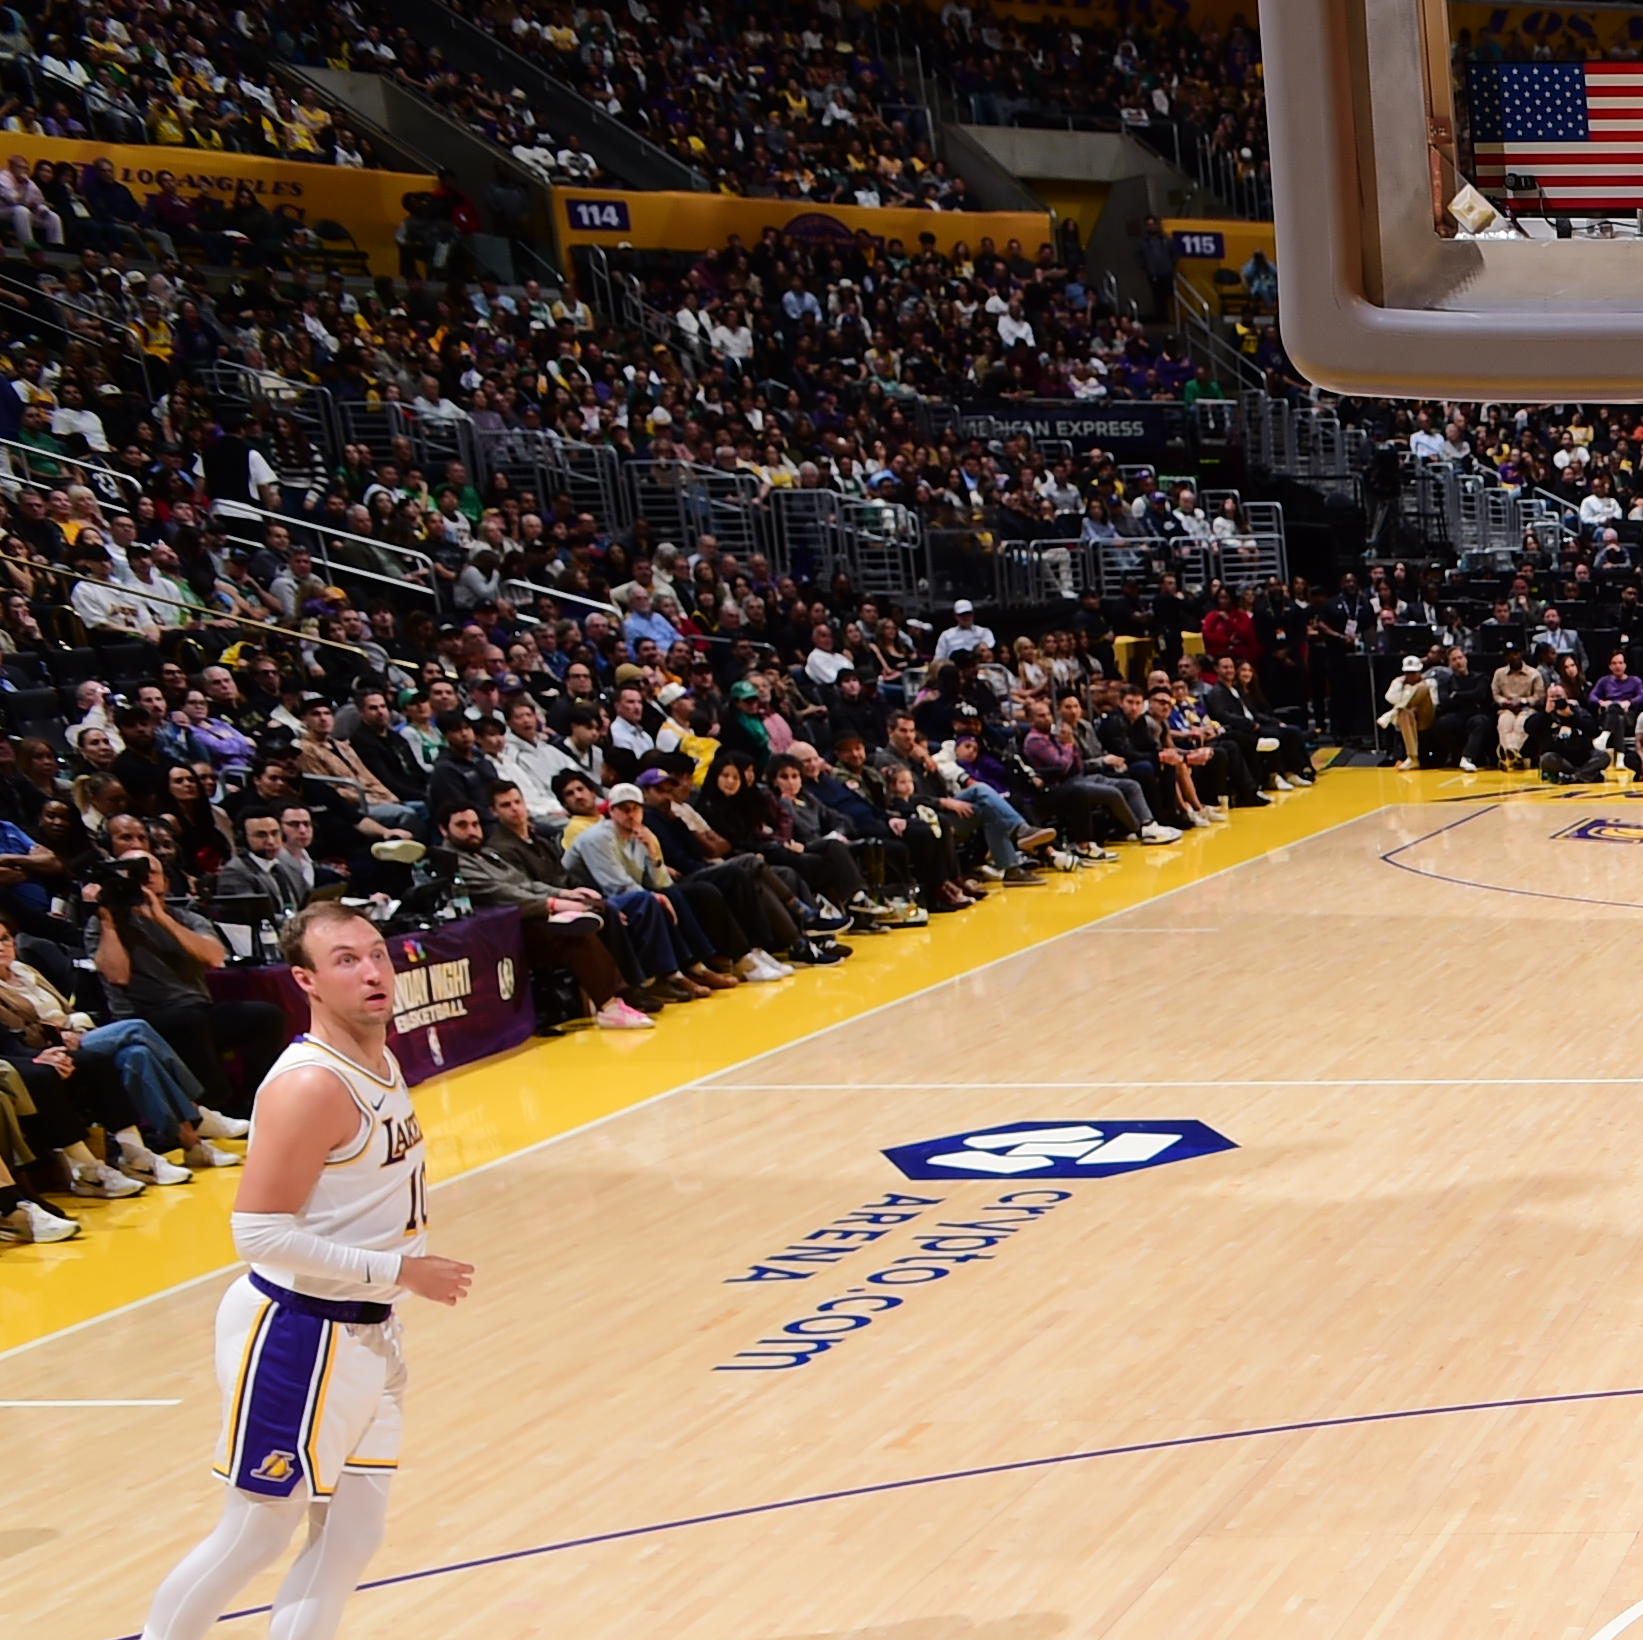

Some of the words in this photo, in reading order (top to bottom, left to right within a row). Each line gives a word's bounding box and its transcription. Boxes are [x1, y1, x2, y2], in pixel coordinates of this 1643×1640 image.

[121, 167, 157, 185] LO
[576, 204, 622, 227] 114
[1181, 234, 1216, 256] 115
[960, 420, 1049, 438] MERICAN
[1055, 420, 1145, 437] EXPRESS
[722, 1192, 948, 1285] ARENA
[710, 1189, 1074, 1372] crypto.com
